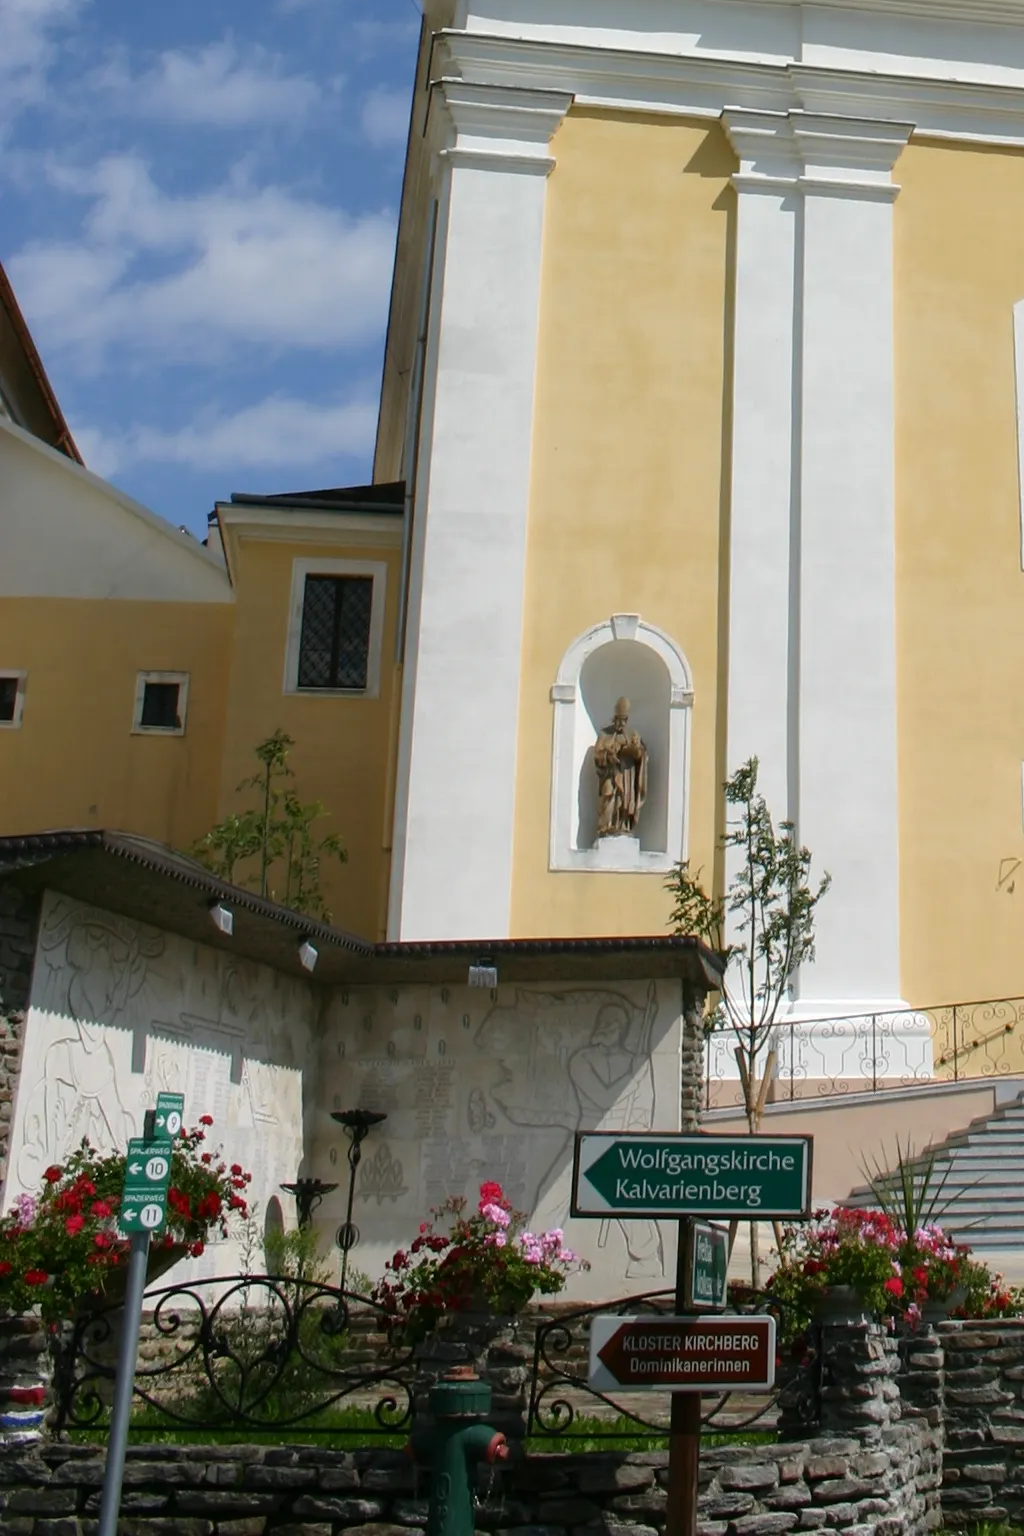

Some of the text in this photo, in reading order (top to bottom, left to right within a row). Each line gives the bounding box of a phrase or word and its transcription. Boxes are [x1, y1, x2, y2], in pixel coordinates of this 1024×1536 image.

[171, 1116, 178, 1129] 9
[129, 1146, 171, 1155] SPAZIERWEG
[149, 1162, 164, 1174] 10
[618, 1148, 795, 1176] Wolfgangskirche
[123, 1194, 165, 1203] SPAZIERWEG
[615, 1178, 762, 1206] Kalvarienberg
[145, 1208, 157, 1222] 11
[622, 1334, 759, 1351] KLOSTER KIRCHBERG
[630, 1357, 750, 1373] Dominikanerinnen
